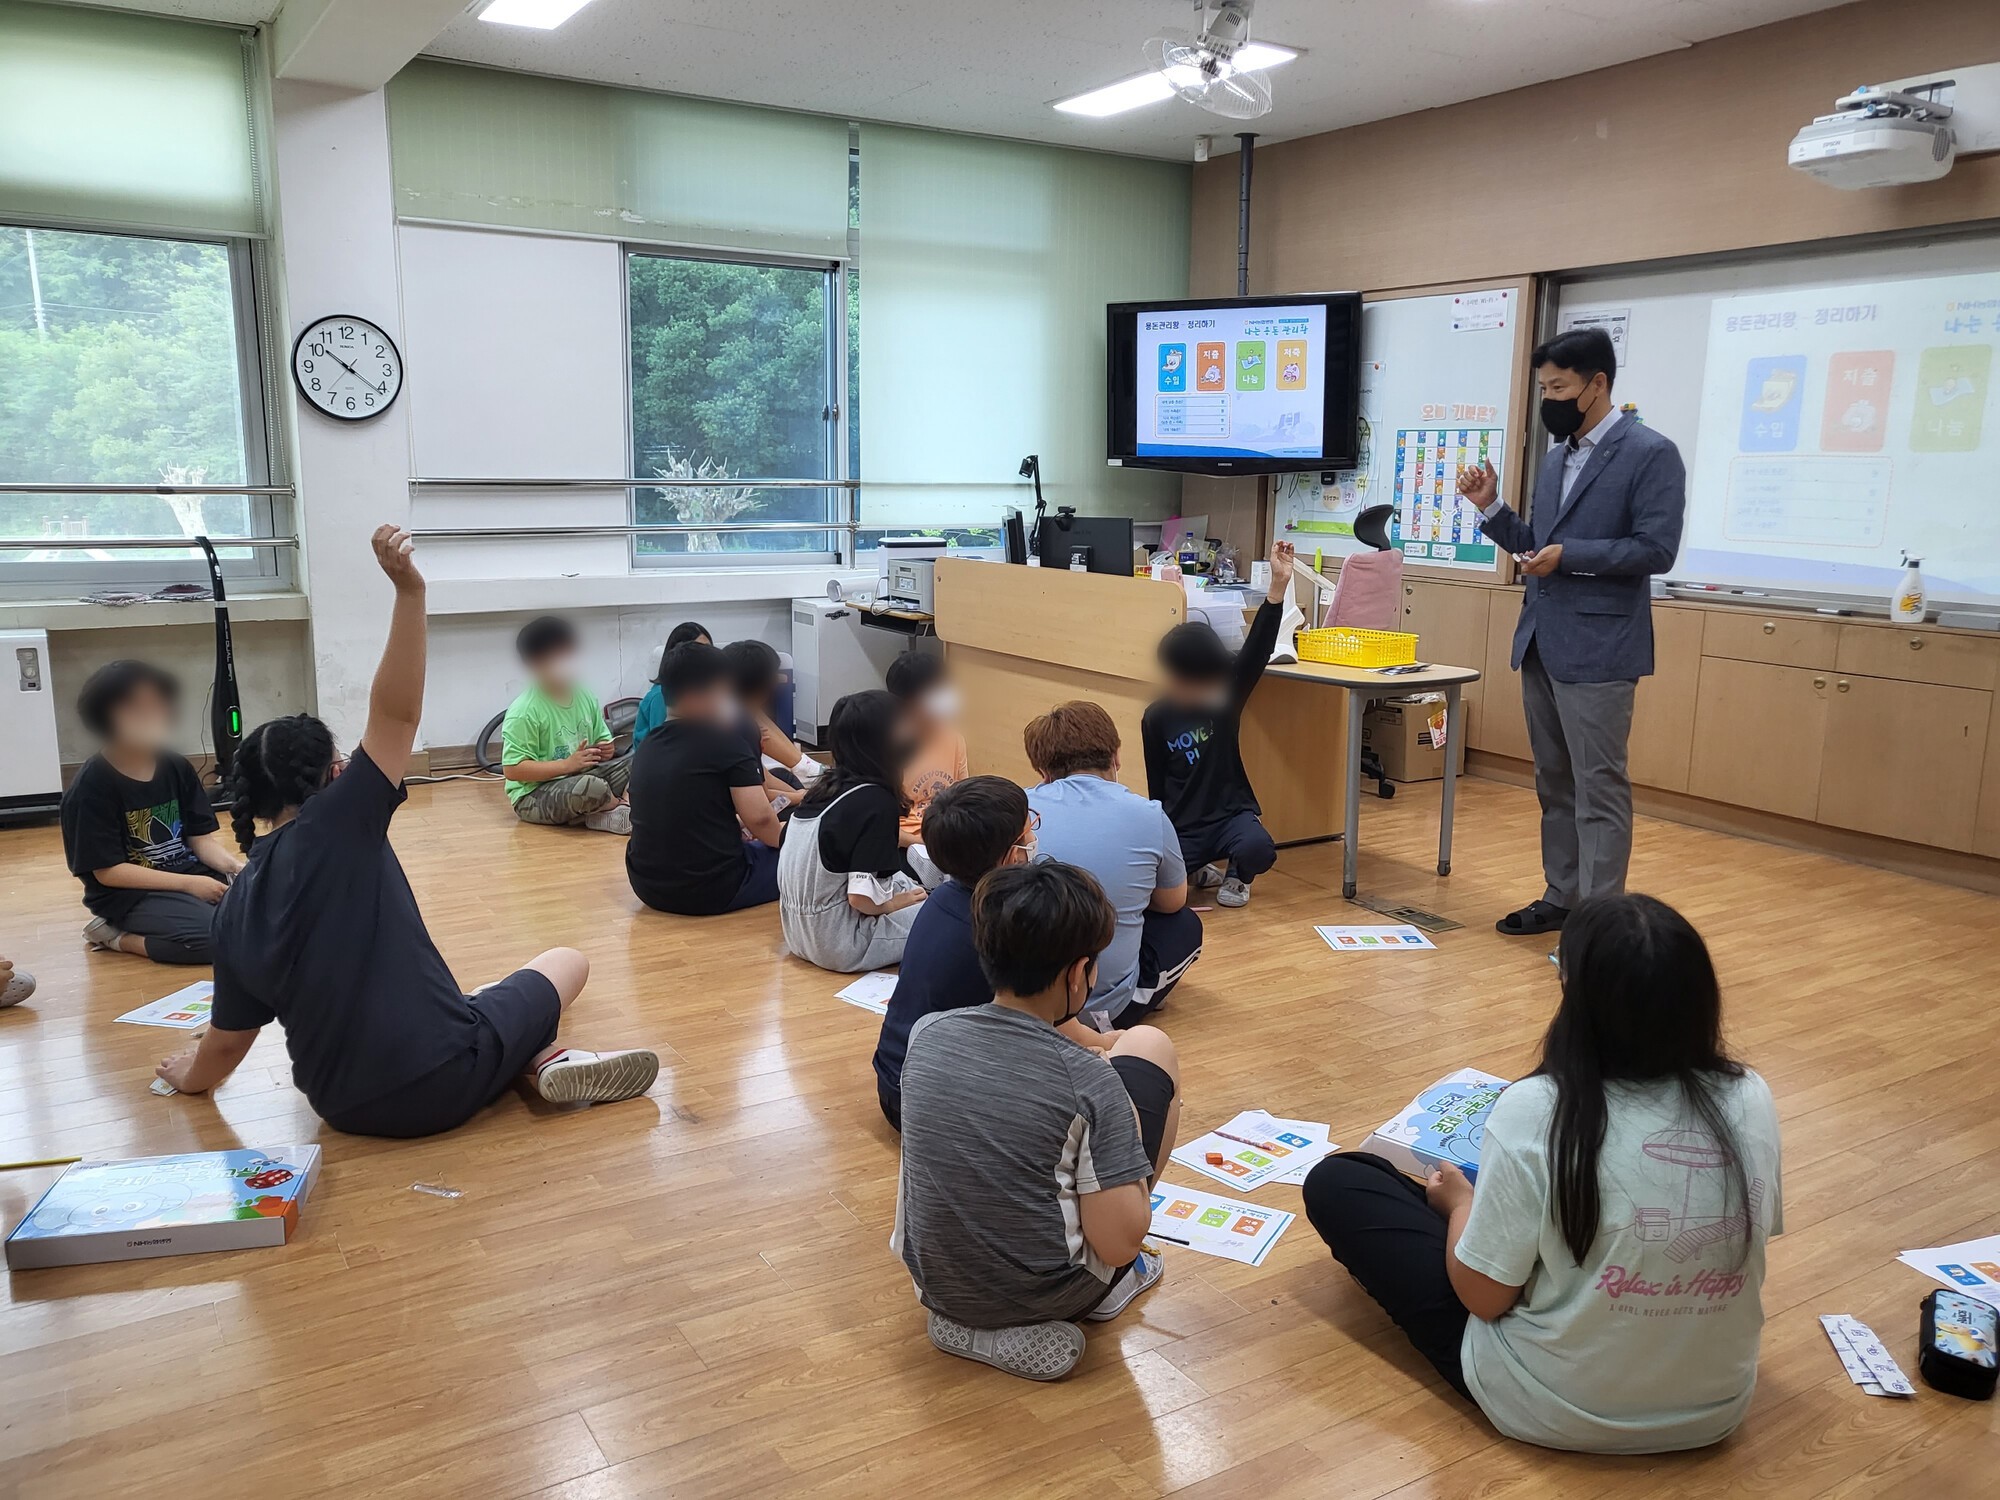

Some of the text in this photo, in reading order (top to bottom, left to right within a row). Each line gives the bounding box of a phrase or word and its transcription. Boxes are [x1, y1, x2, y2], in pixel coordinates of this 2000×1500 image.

[1725, 304, 1877, 332] 용돈관리왕 정리하기
[1145, 320, 1216, 330] 용돈관리왕 정리하기
[319, 331, 332, 344] 11
[338, 326, 354, 340] 12
[361, 332, 367, 345] 1
[308, 343, 324, 357] 10
[375, 345, 385, 358] 2
[1203, 350, 1220, 360] 지출
[303, 360, 314, 373] 9
[382, 364, 392, 377] 3
[1164, 376, 1180, 385] 수입
[1242, 375, 1259, 384] 나눔
[1843, 368, 1879, 386] 지출
[311, 378, 321, 391] 8
[377, 381, 387, 393] 4
[327, 392, 337, 404] 7
[346, 397, 355, 410] 6
[365, 393, 374, 406] 5
[1421, 404, 1498, 422] 오늘 기분은?
[1754, 423, 1785, 438] 수입
[1167, 727, 1209, 752] MOVE
[1595, 1265, 1748, 1300] Relax in Happy
[1619, 1305, 1638, 1315] GIRL
[1643, 1308, 1670, 1316] NEVER
